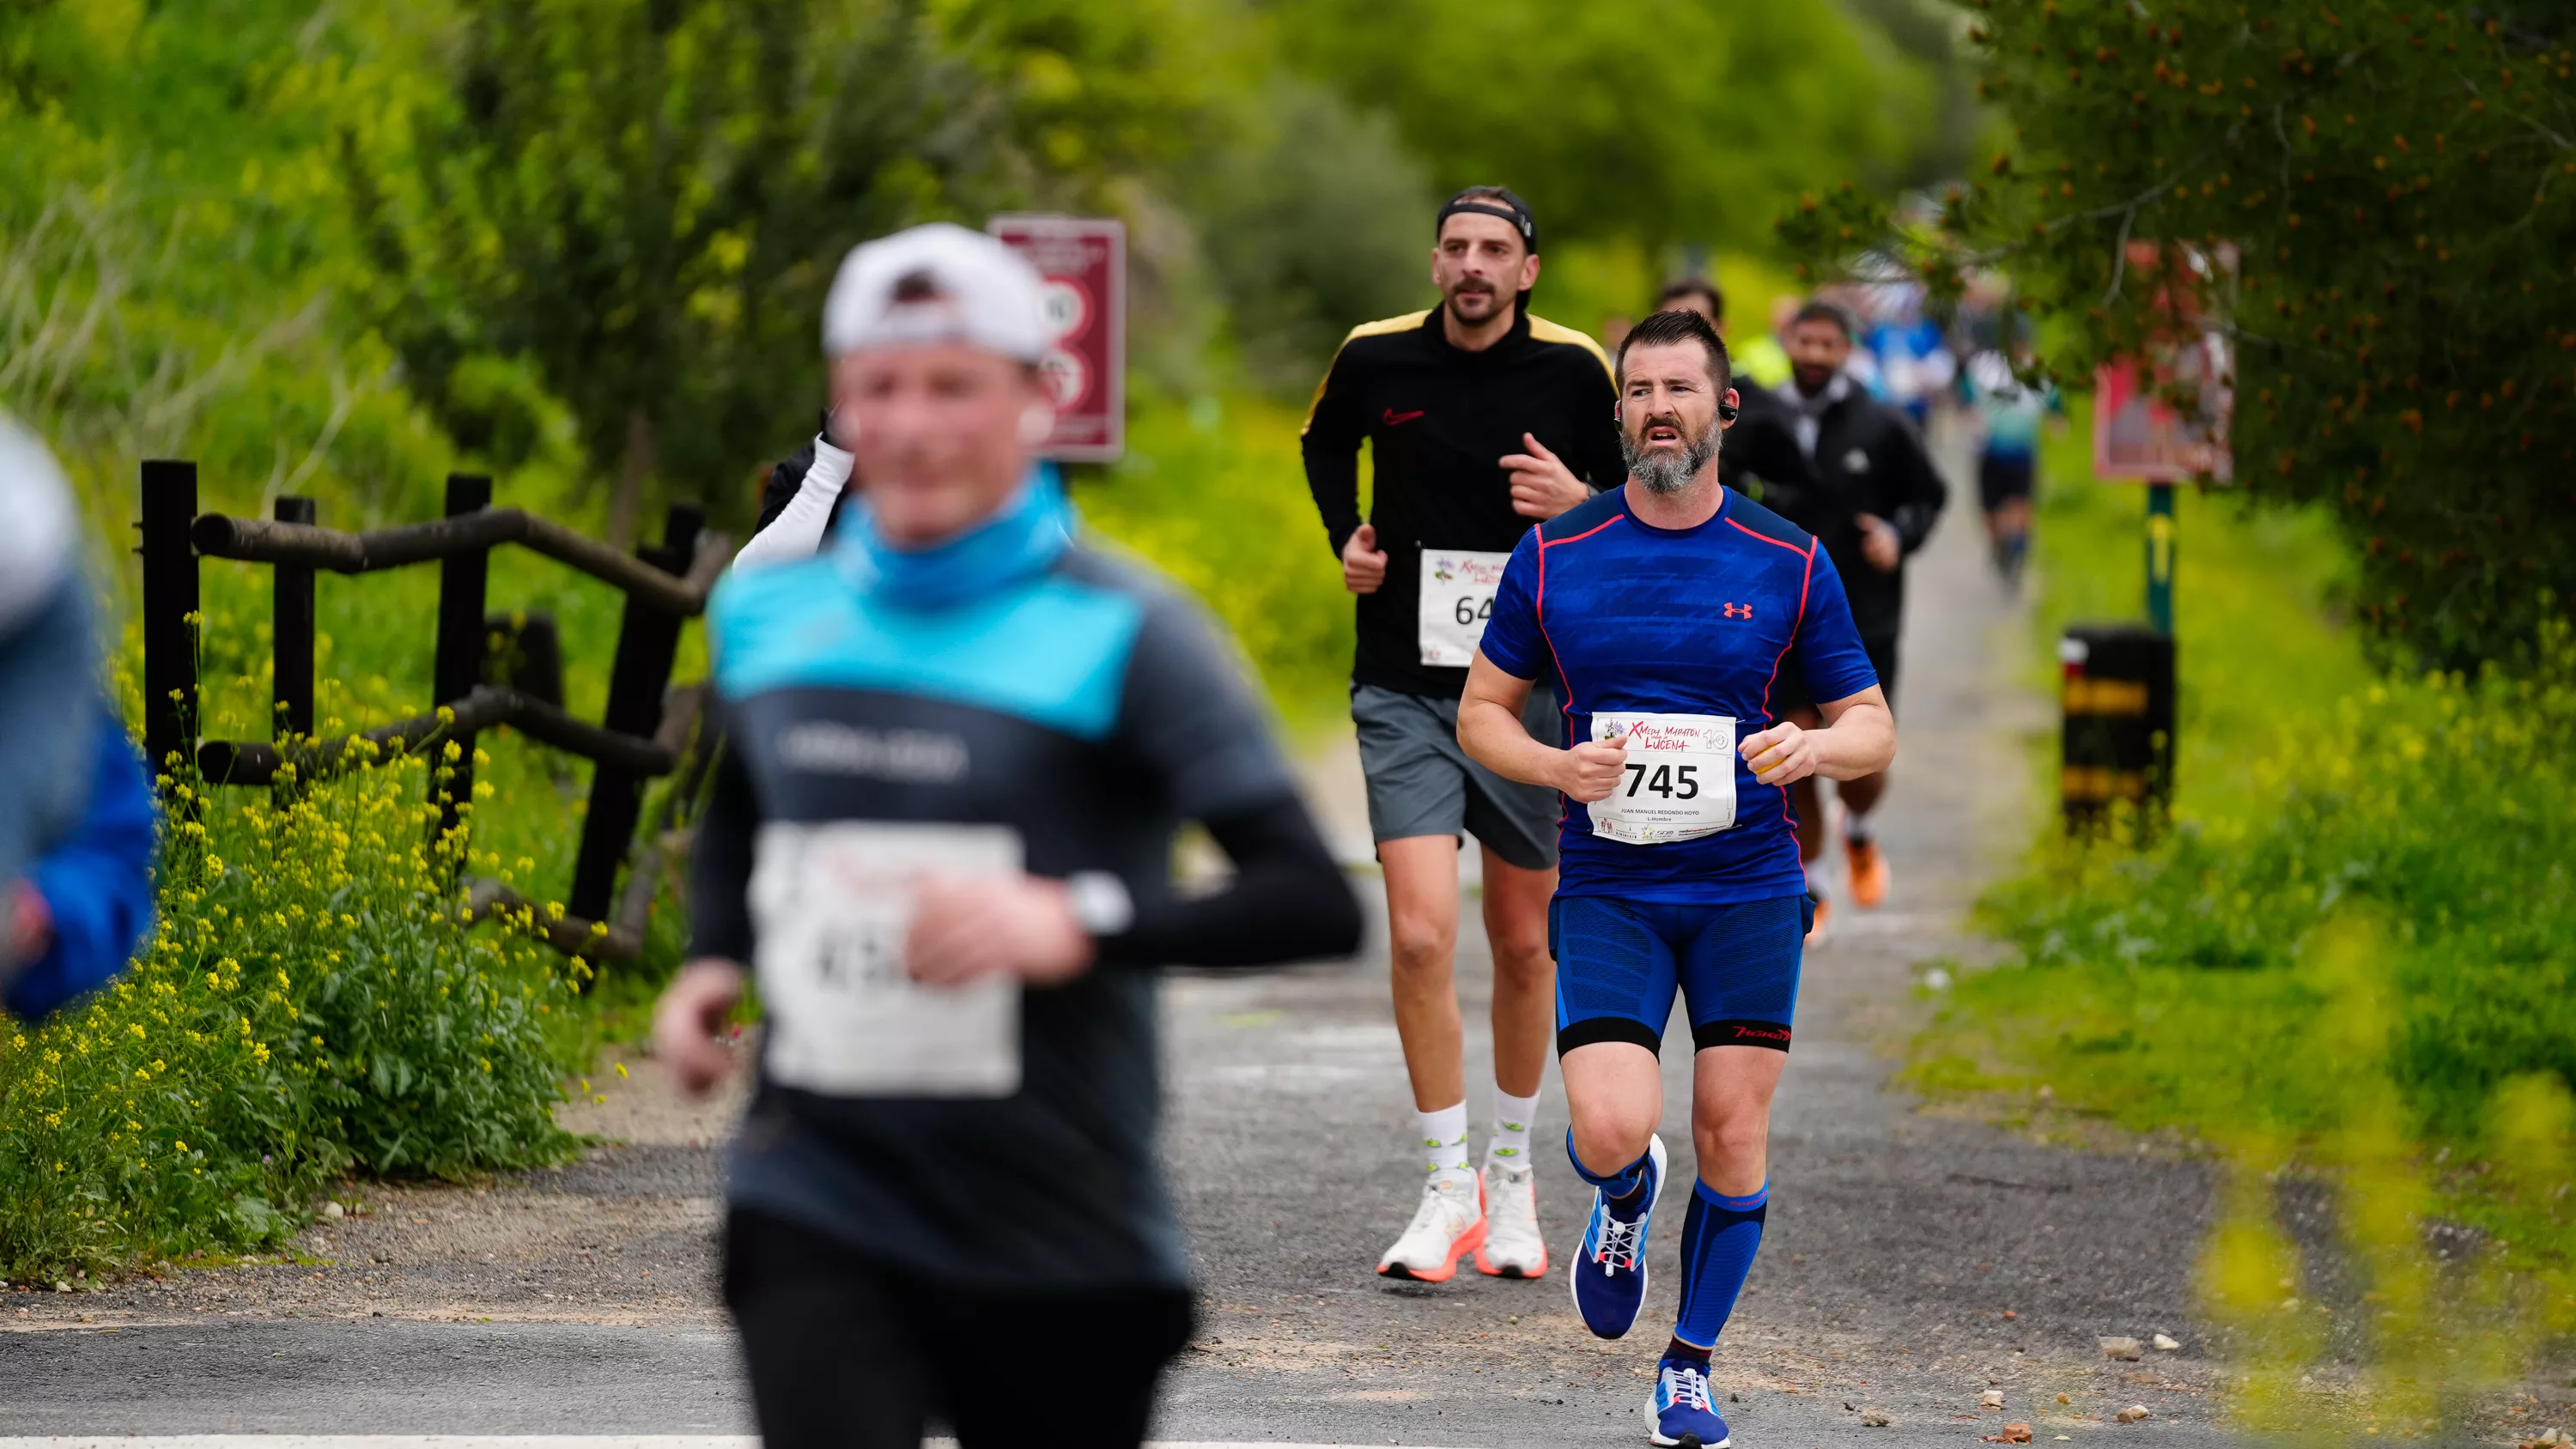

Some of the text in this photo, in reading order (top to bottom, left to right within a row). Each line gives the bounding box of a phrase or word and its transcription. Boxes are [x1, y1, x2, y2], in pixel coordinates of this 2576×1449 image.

[1628, 720, 1644, 739] X
[1645, 737, 1691, 752] LUCENA
[1625, 763, 1698, 799] 745
